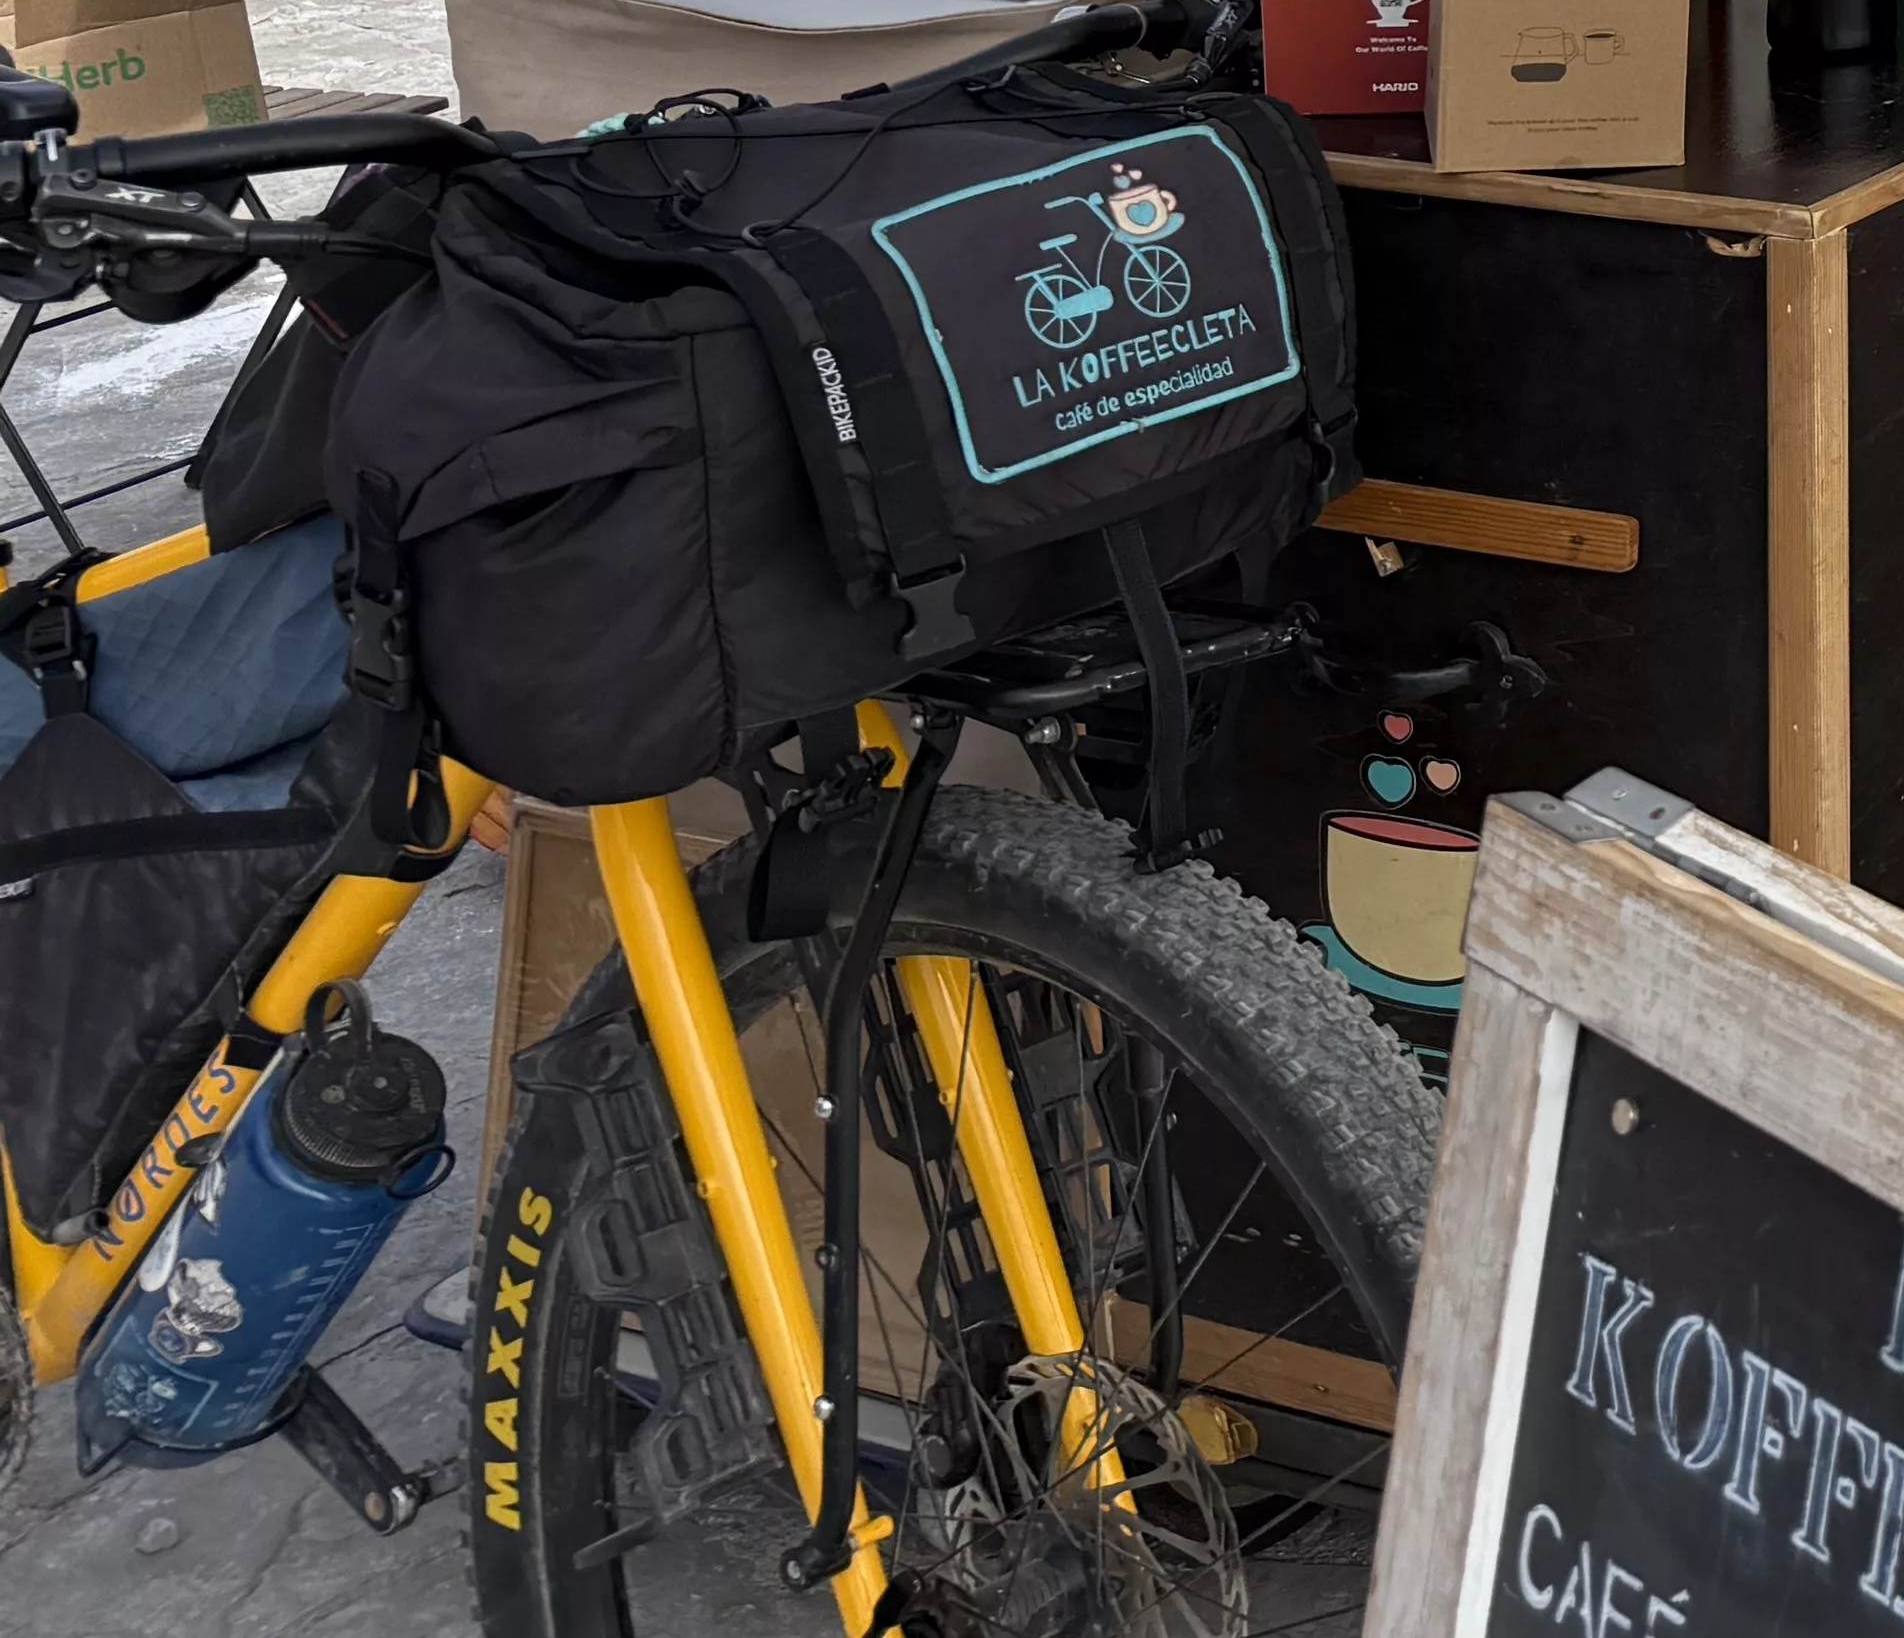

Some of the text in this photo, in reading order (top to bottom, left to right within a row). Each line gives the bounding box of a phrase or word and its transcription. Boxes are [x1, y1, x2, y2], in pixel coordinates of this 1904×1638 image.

[26, 47, 147, 94] Herb
[1372, 82, 1419, 93] HARIO
[105, 186, 165, 204] XT
[1013, 303, 1257, 408] LA KOFFEECLETA
[812, 346, 857, 443] BIKEPACKID
[1096, 396, 1121, 417] de
[1124, 356, 1235, 405] especialidad
[484, 1185, 553, 1532] MAXXIS
